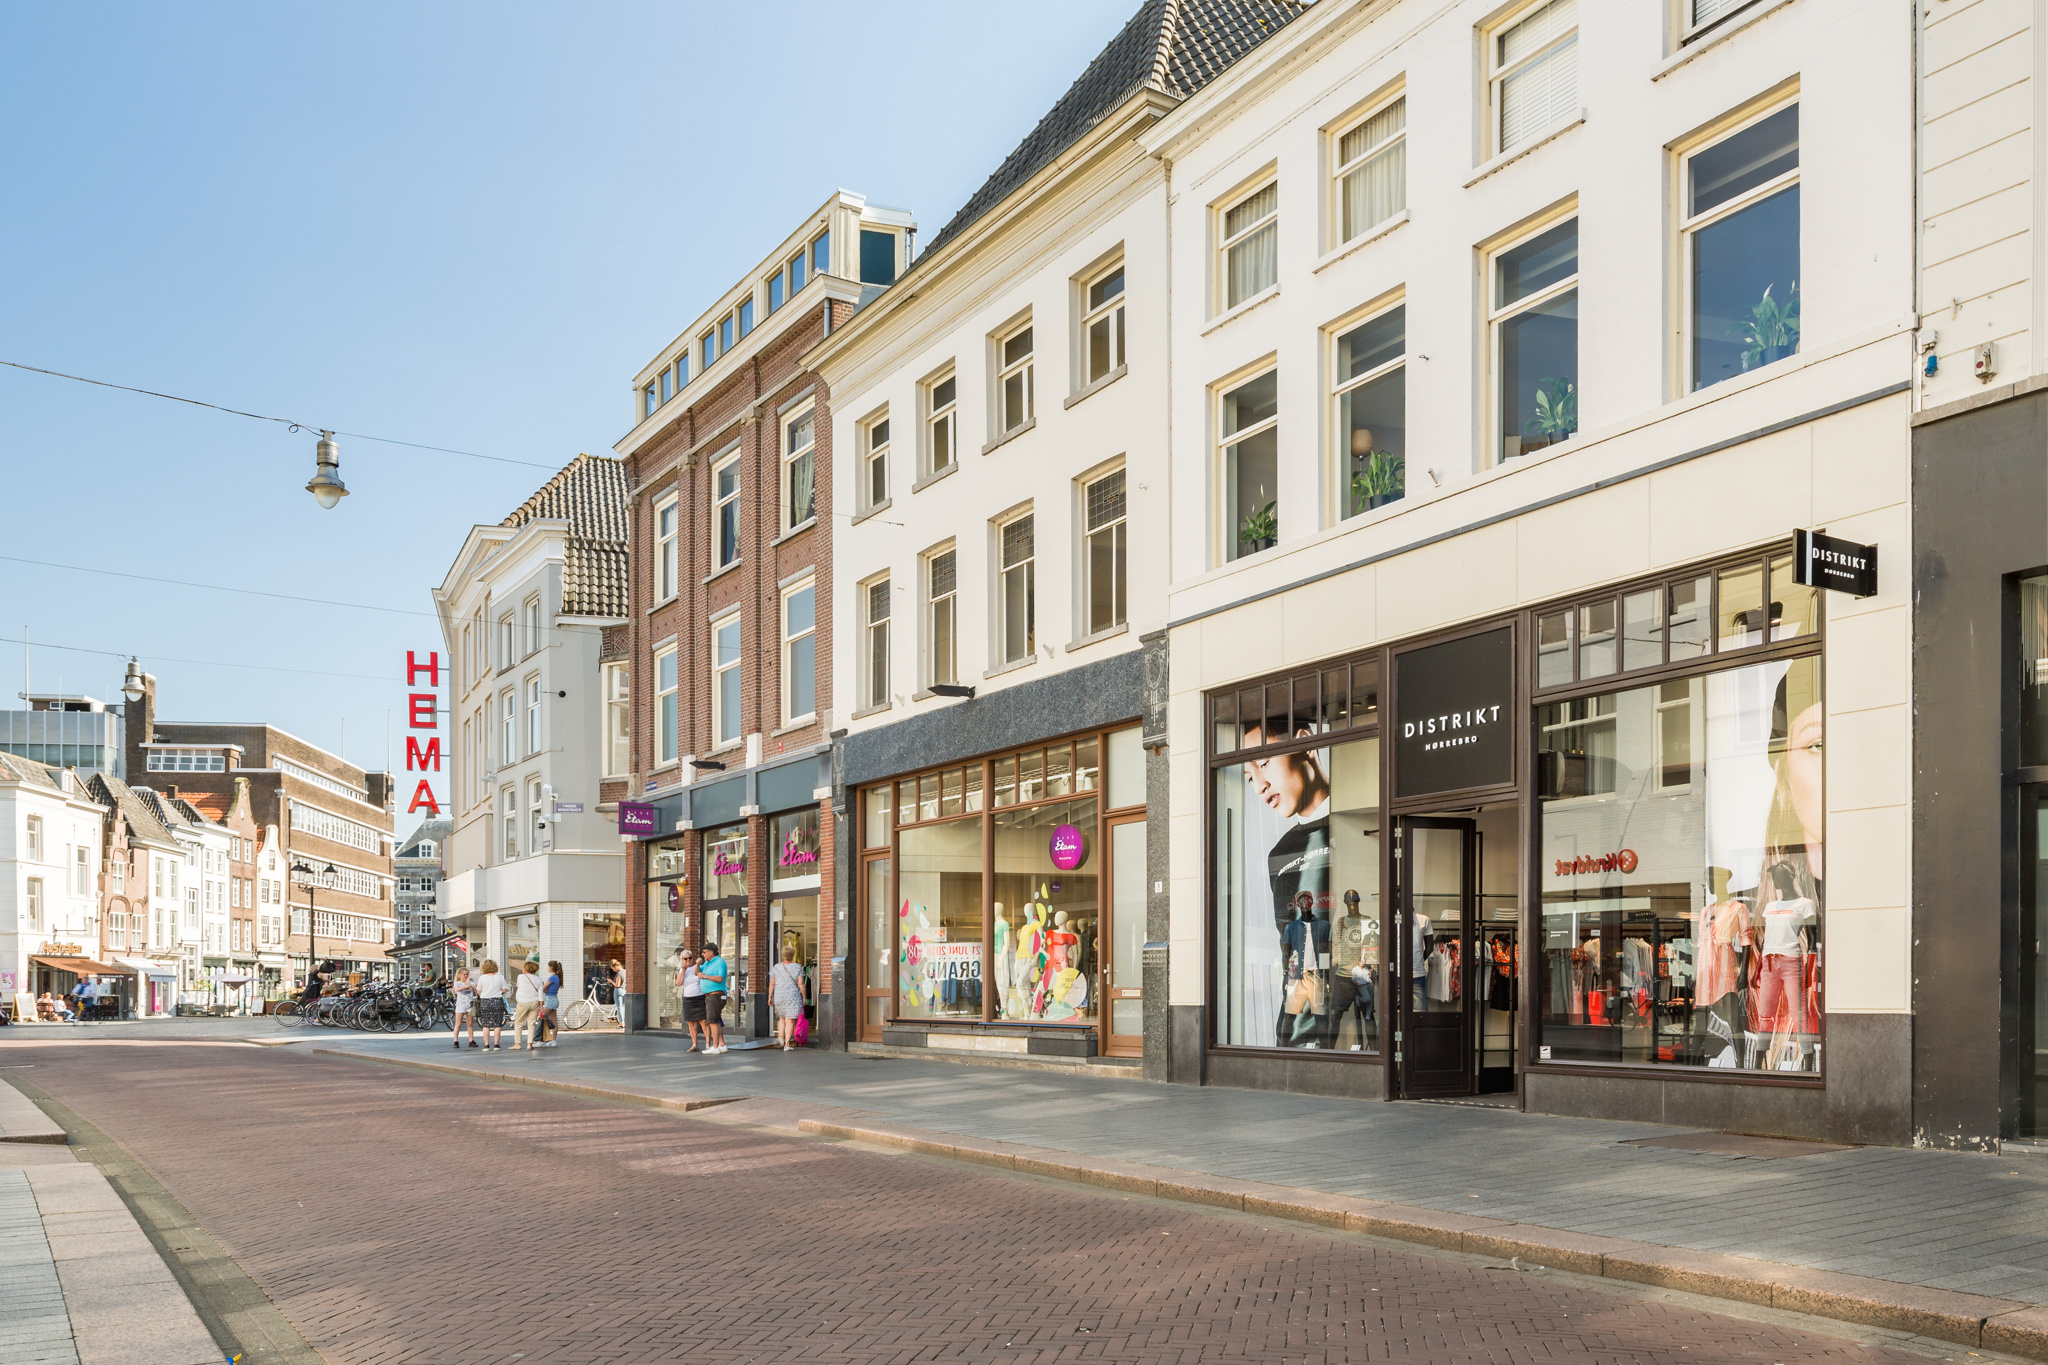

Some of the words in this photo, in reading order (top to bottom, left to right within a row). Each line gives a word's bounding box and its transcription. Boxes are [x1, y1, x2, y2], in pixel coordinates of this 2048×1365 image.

[1812, 547, 1867, 570] DISTRIKT
[406, 650, 441, 814] HEMA
[1404, 705, 1500, 738] DISTRIKT
[1425, 735, 1478, 751] NØRREBRO
[624, 813, 653, 824] Etam
[781, 840, 818, 866] Etam
[1055, 840, 1077, 851] Etam
[713, 852, 745, 876] Etam
